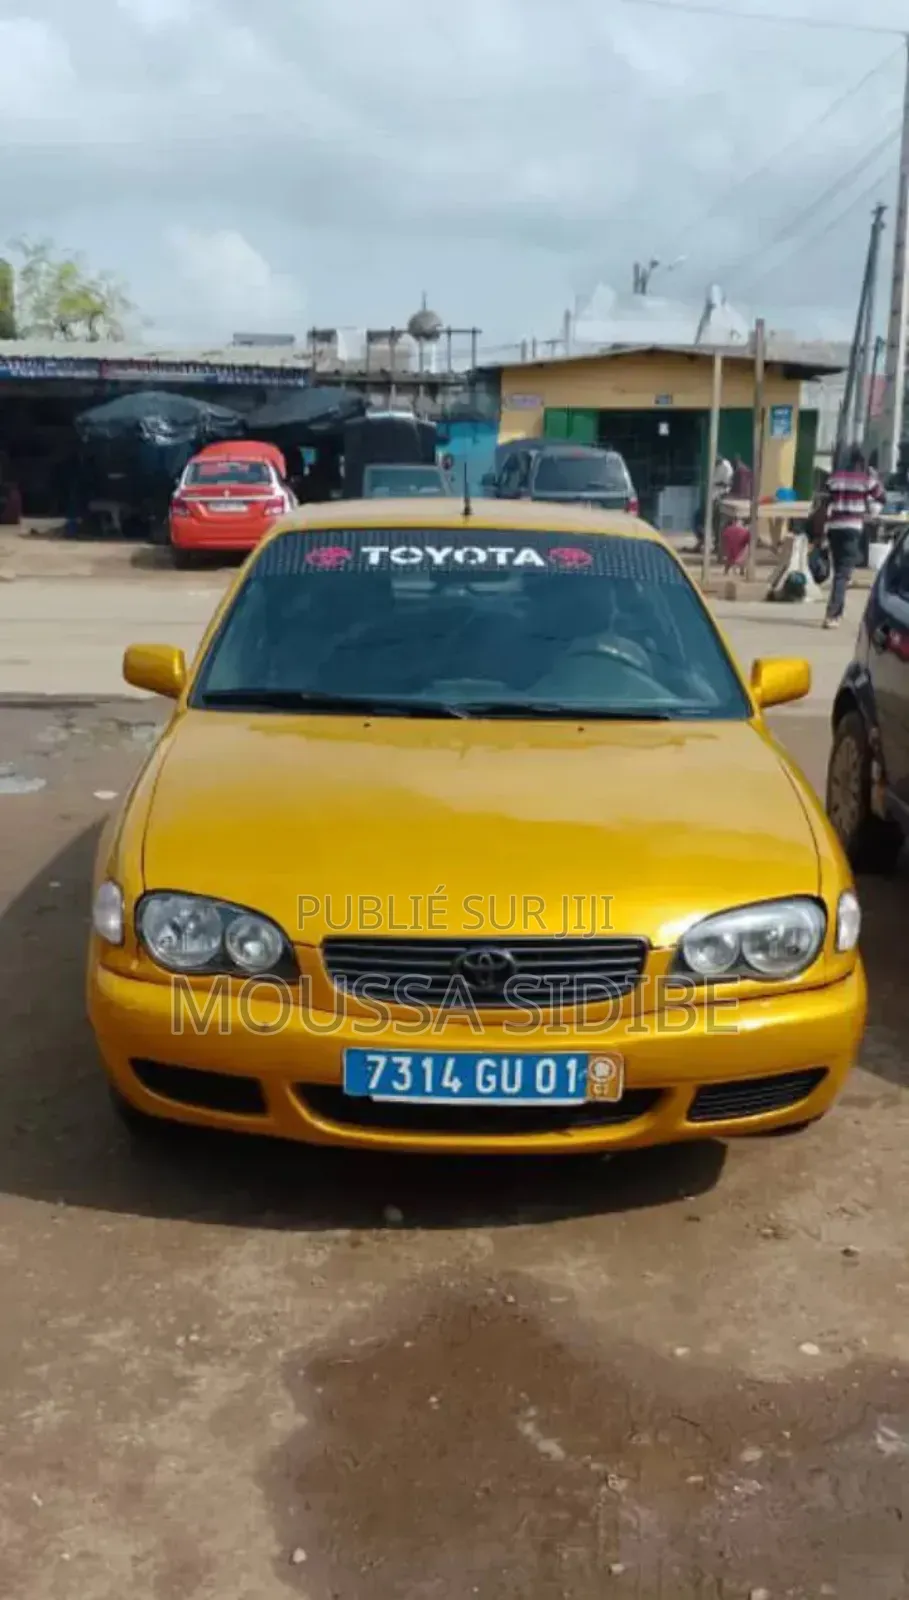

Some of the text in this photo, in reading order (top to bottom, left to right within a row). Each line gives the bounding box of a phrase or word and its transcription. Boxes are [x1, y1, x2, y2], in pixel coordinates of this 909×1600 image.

[361, 546, 545, 566] TOYOTA
[366, 1055, 578, 1094] 7314 GU 01
